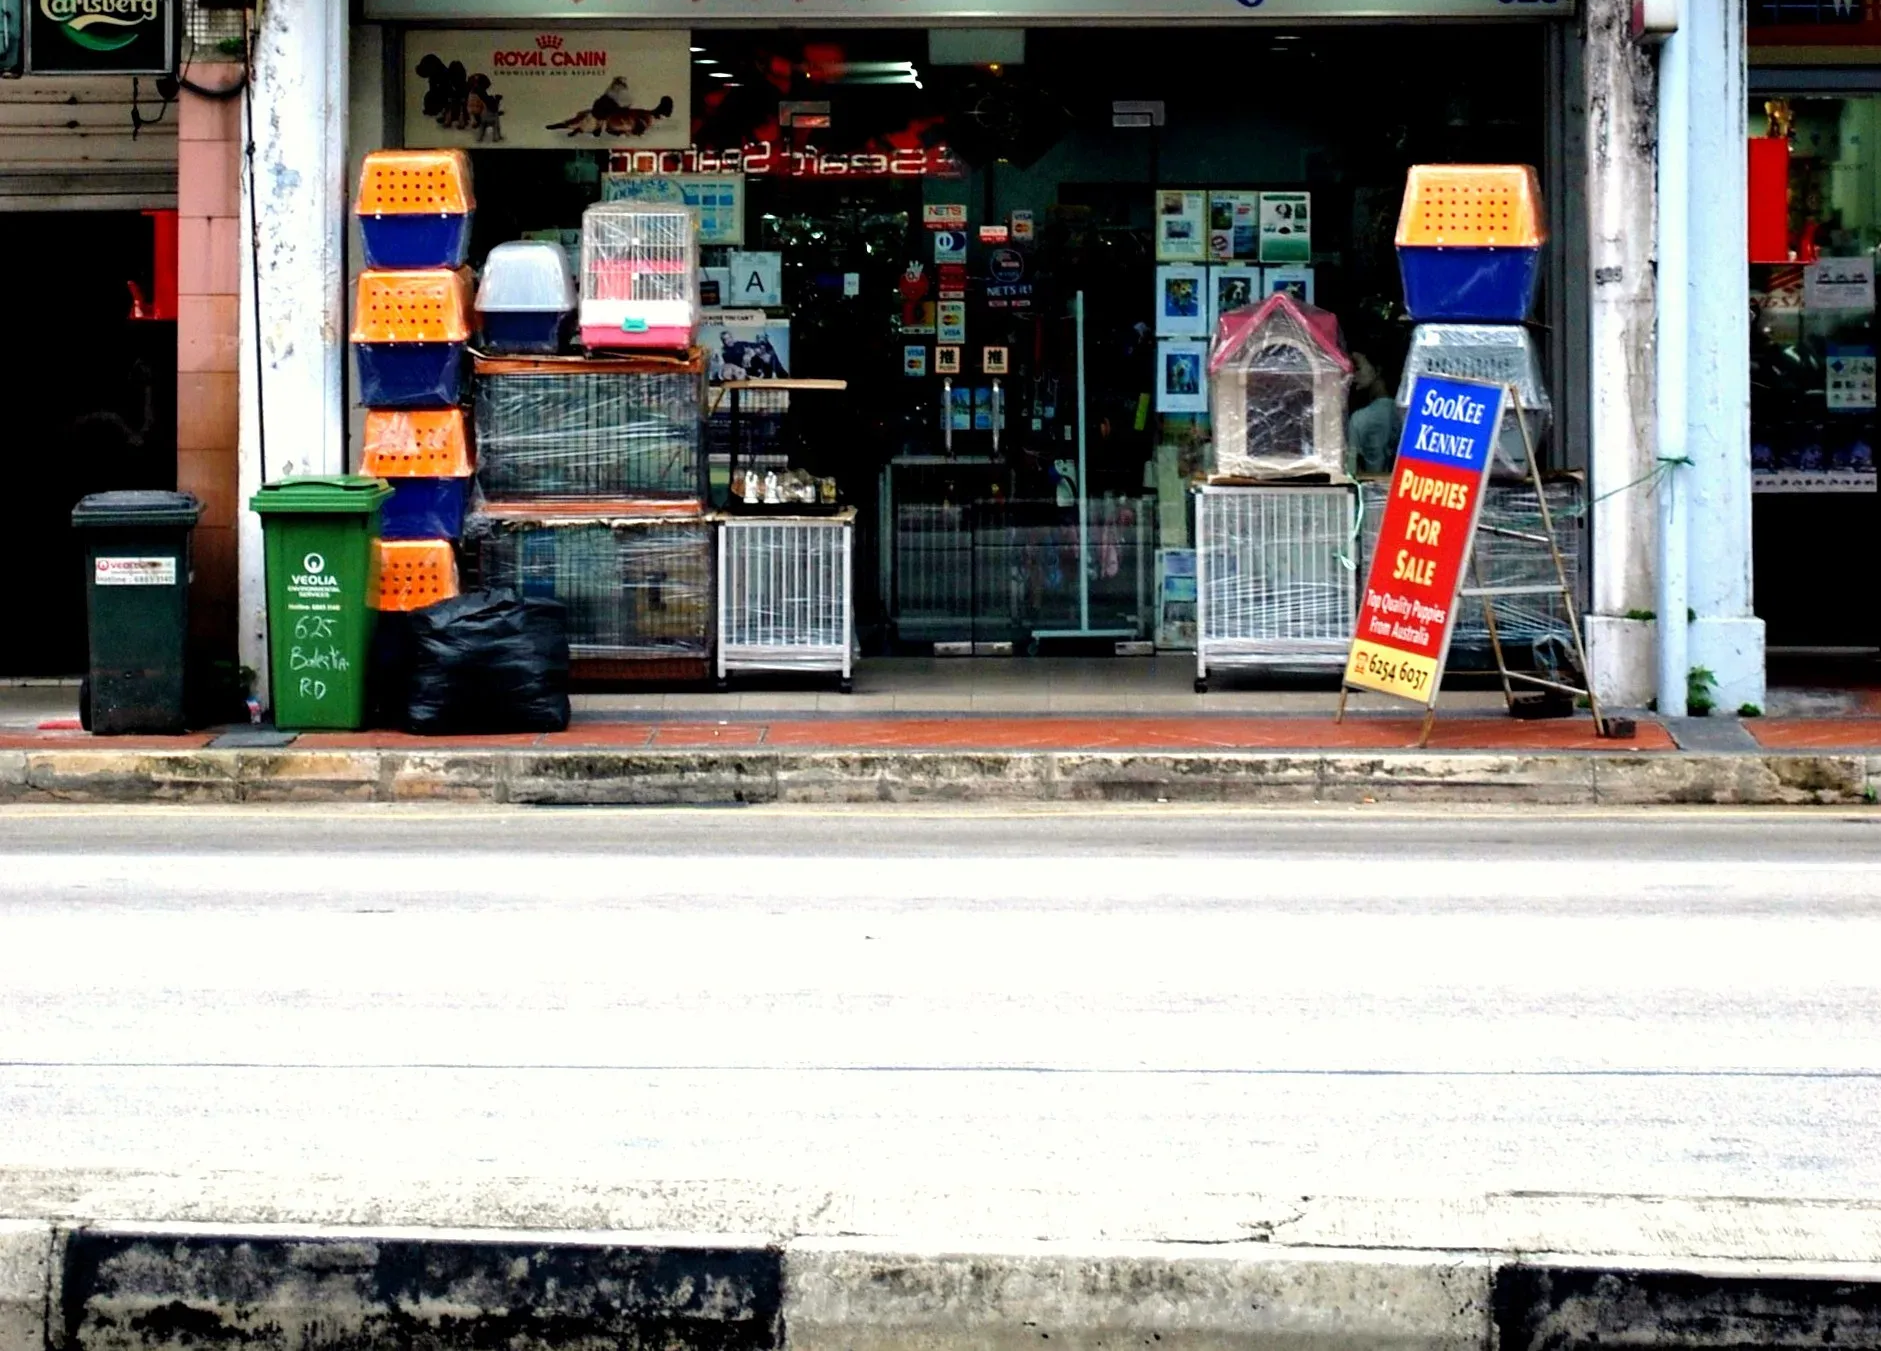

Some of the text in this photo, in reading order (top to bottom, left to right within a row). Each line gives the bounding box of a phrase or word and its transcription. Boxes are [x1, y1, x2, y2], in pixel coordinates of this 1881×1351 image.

[494, 51, 606, 66] ROYAL CANIN
[745, 271, 765, 293] A
[291, 574, 338, 586] VEOLIA
[1366, 589, 1447, 626] Top Quality Puppies
[294, 614, 339, 640] 625
[1369, 615, 1430, 646] From Australia
[1369, 653, 1428, 691] 6254 6037
